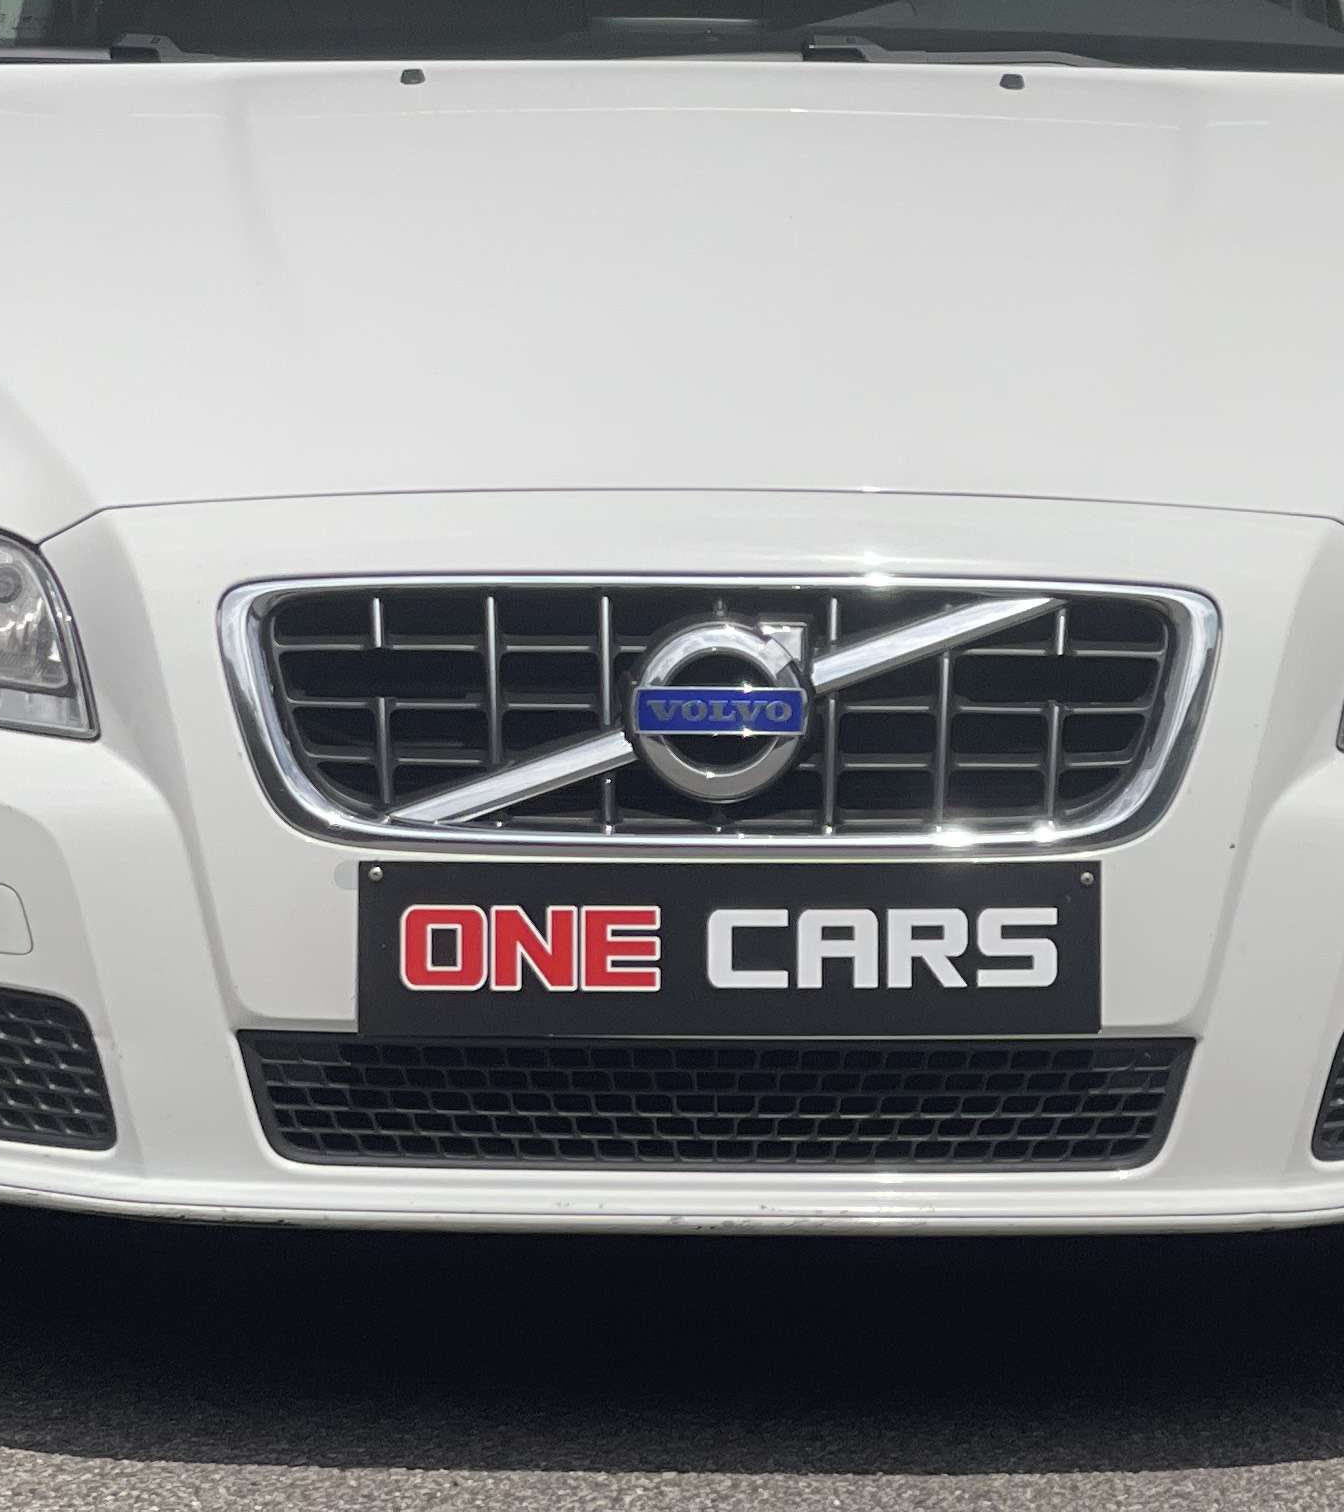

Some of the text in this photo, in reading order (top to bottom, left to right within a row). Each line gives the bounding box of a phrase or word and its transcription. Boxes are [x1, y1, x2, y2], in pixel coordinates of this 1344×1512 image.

[646, 699, 793, 723] VOLVO
[399, 903, 1059, 992] ONE CARS
